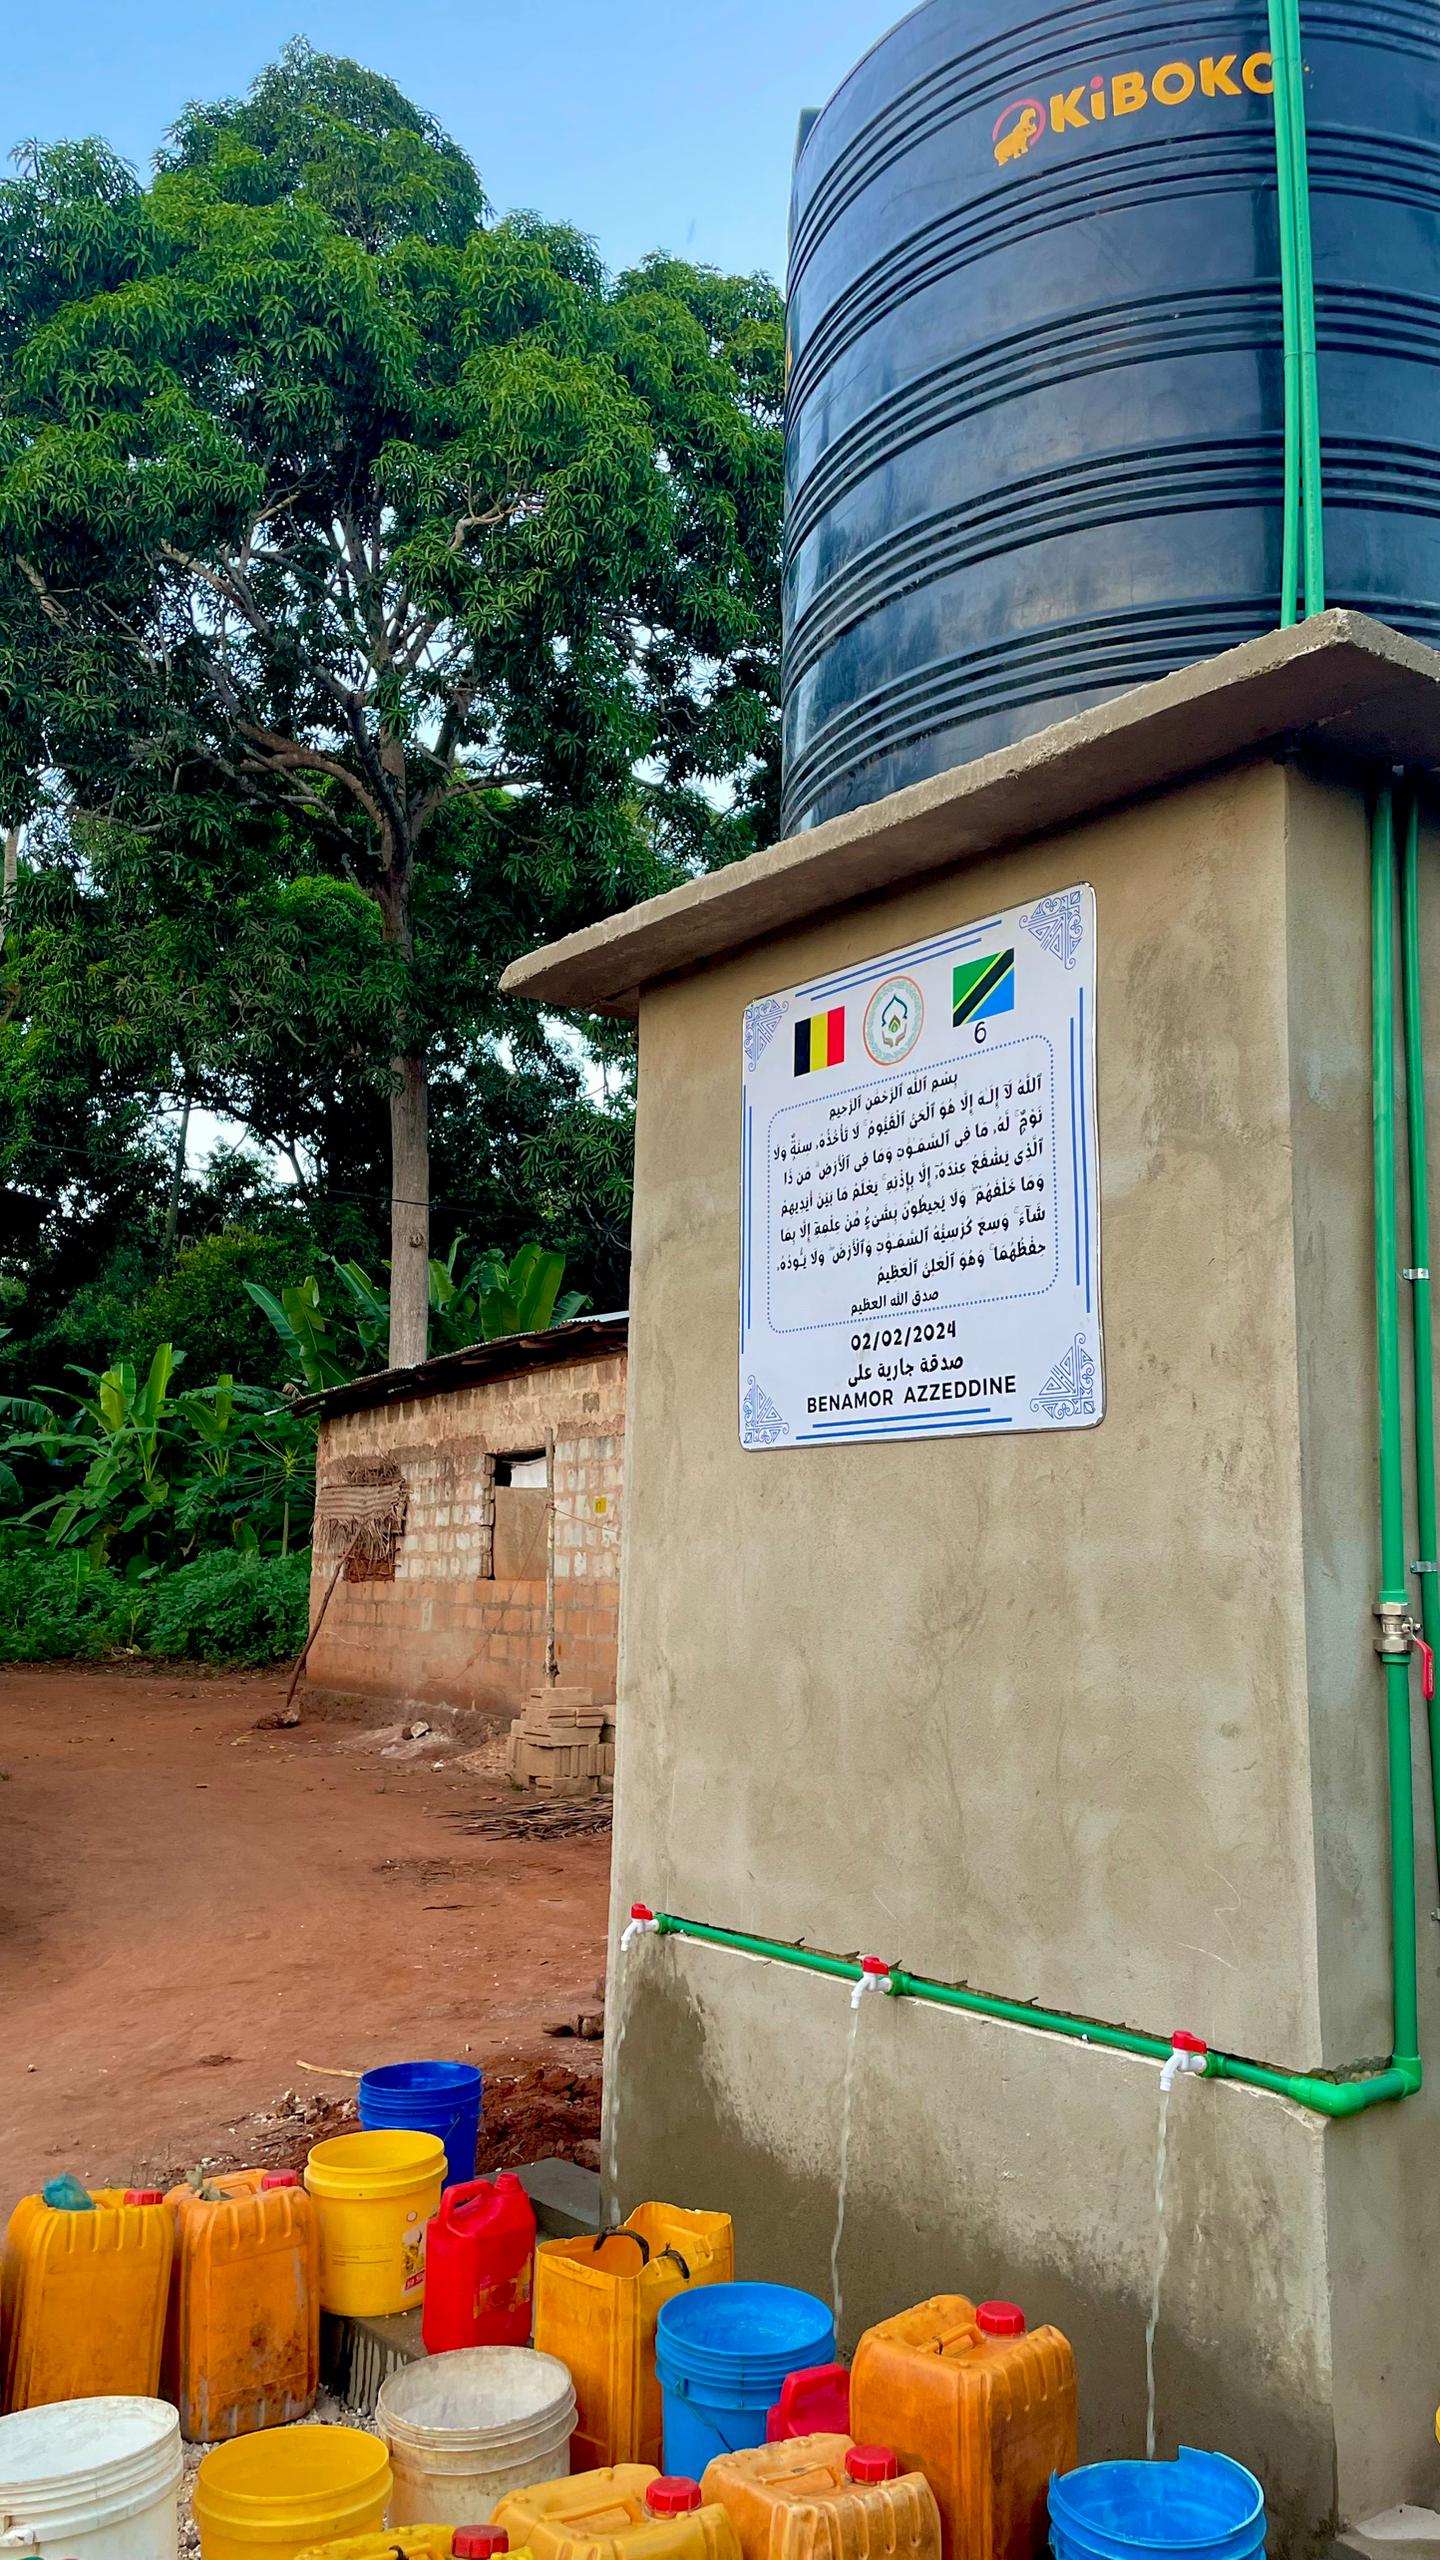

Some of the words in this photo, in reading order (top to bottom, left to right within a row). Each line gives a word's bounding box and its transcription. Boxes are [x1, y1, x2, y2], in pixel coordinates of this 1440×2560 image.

[1049, 51, 1274, 133] KiBOKO
[974, 1021, 986, 1044] 6
[851, 1295, 886, 1316] العظيم
[890, 1290, 908, 1307] الله
[912, 1290, 939, 1306] صدق
[851, 1320, 956, 1351] 02/02/2024
[877, 1357, 914, 1382] جارية
[920, 1354, 963, 1373] صدقة
[807, 1388, 893, 1414] BENAMOR
[904, 1375, 1016, 1404] AZZEDDINE
